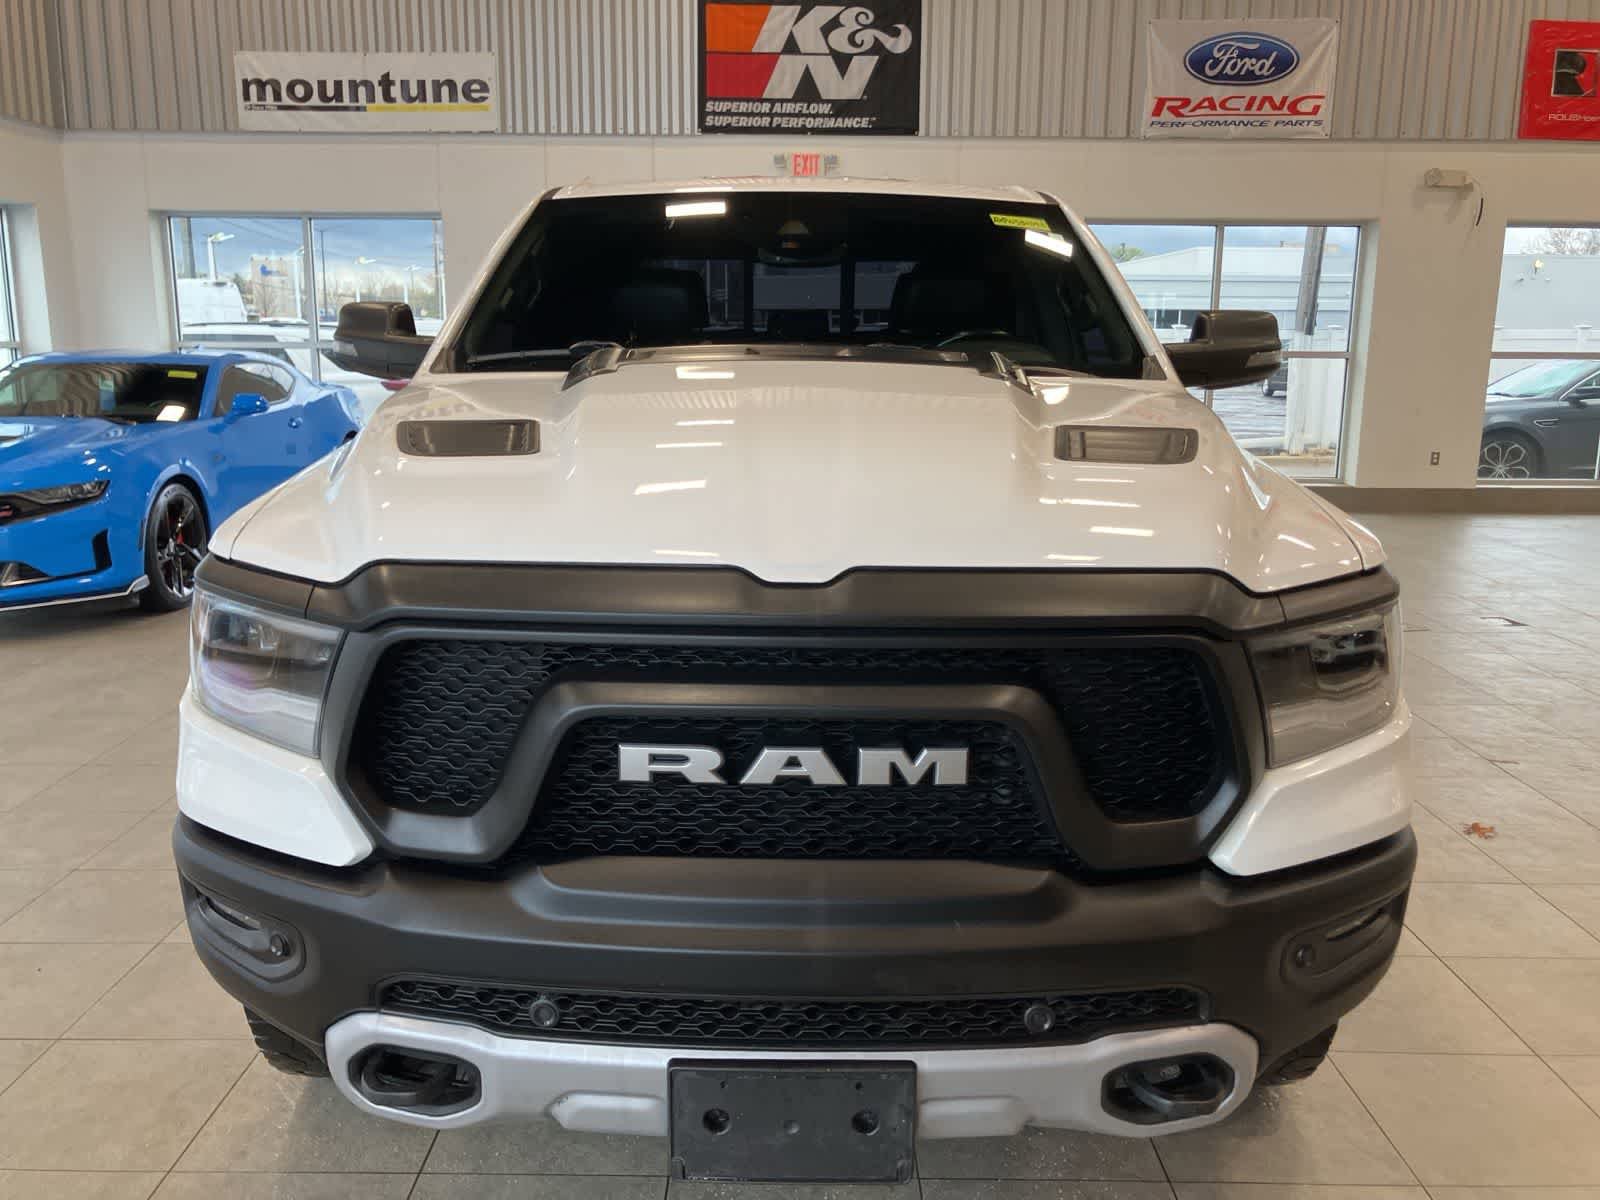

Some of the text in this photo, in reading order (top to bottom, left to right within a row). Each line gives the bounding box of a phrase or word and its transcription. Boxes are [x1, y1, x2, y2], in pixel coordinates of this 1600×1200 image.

[1204, 41, 1278, 77] Ford
[242, 71, 491, 104] mountune
[705, 101, 833, 114] SUPERIOR AIRFLOW.
[1151, 95, 1325, 118] RACING
[705, 115, 770, 127] SUPERIOR
[1150, 119, 1324, 128] PERFORMANCE PARTS
[792, 154, 821, 176] EXIT
[618, 744, 968, 785] RAM
